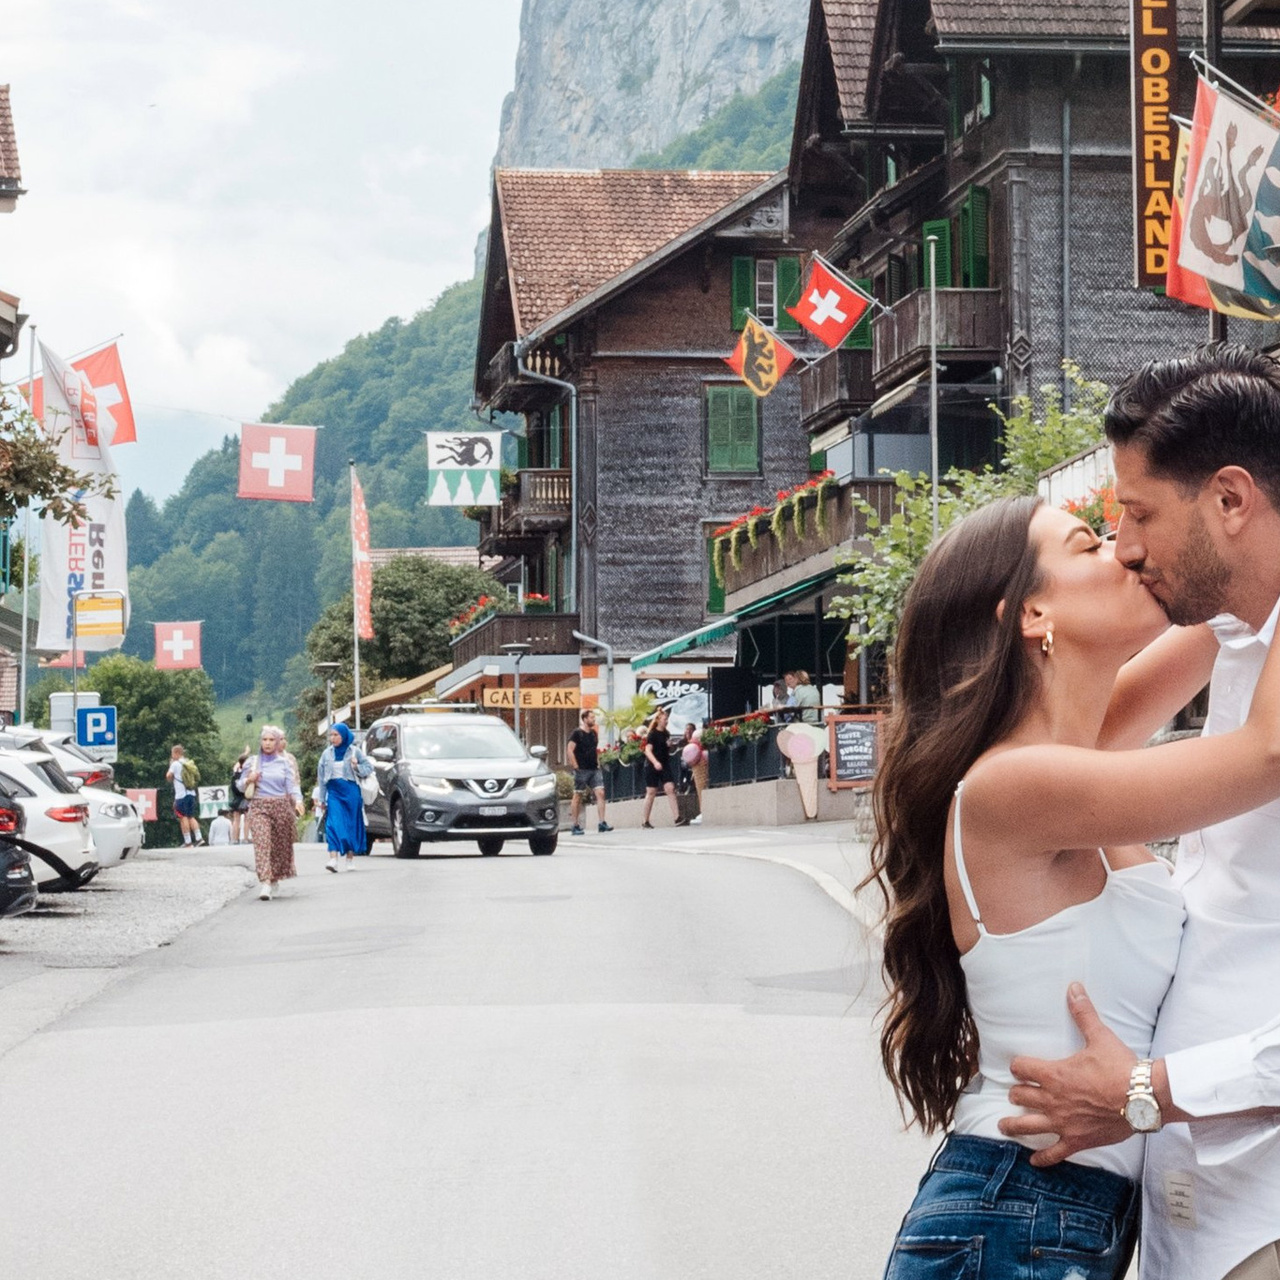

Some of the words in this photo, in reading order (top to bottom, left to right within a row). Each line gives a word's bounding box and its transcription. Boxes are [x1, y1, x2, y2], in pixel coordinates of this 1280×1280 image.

[1141, 47, 1172, 275] OBERLAND
[542, 690, 575, 705] BAR
[639, 679, 705, 699] Coffee
[86, 712, 107, 742] P
